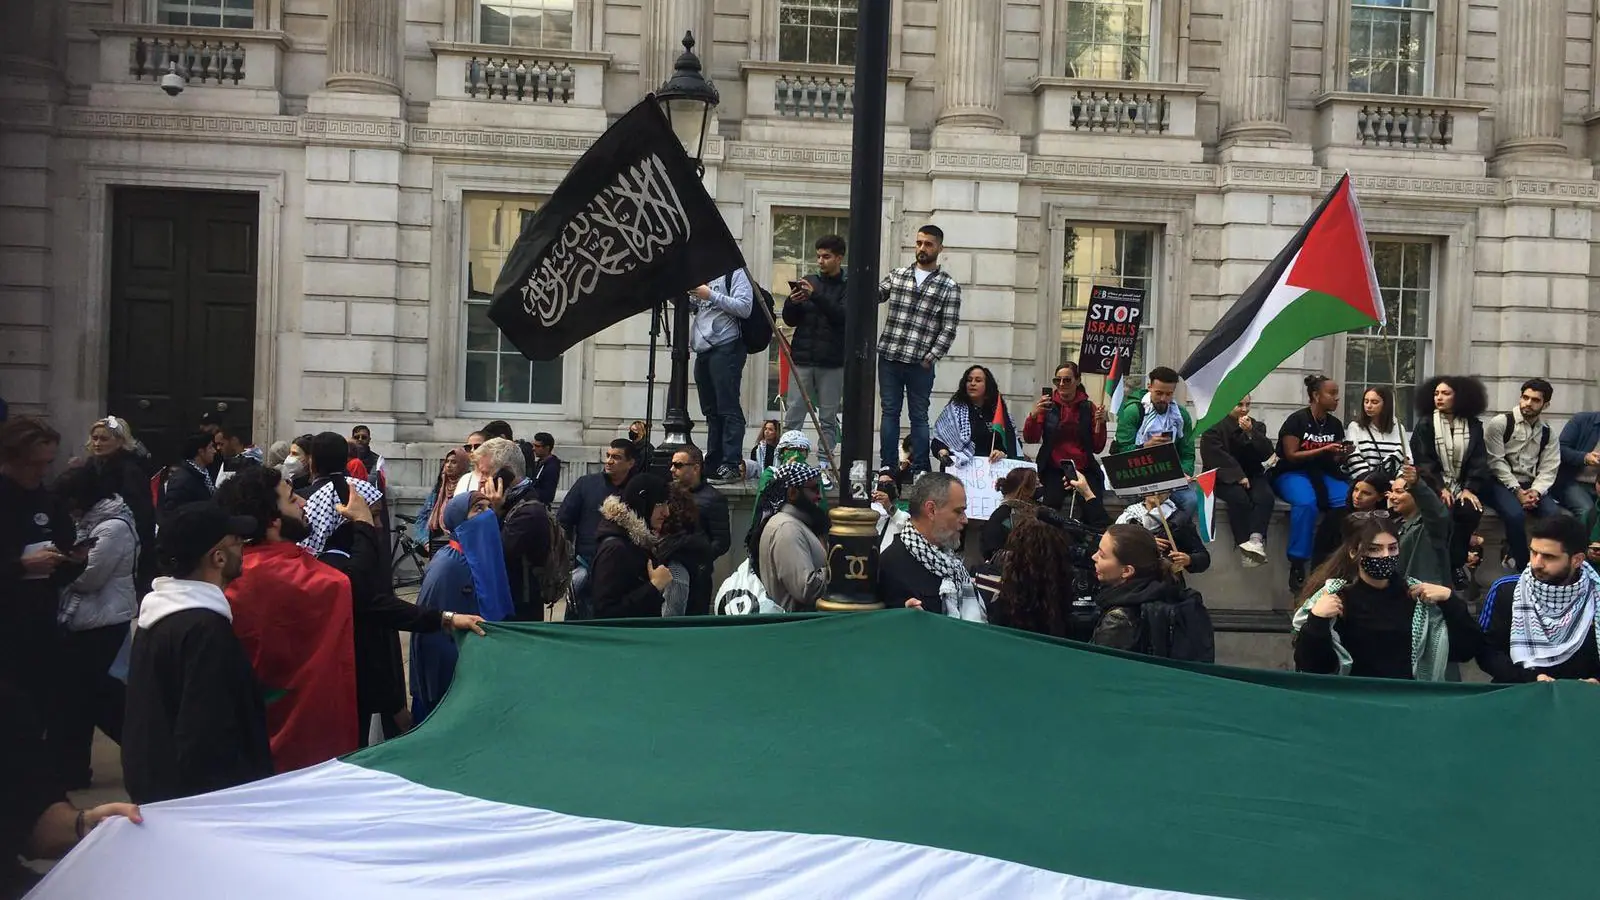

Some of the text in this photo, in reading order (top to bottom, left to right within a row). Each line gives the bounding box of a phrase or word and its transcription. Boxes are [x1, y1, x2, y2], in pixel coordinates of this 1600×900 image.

[1090, 303, 1140, 323] STOP
[1087, 321, 1136, 336] ISRAEL'S
[1086, 333, 1133, 345] WAR CRIMES
[1084, 343, 1096, 354] IN
[1127, 454, 1154, 468] FREE
[1116, 461, 1173, 480] PALESTINE
